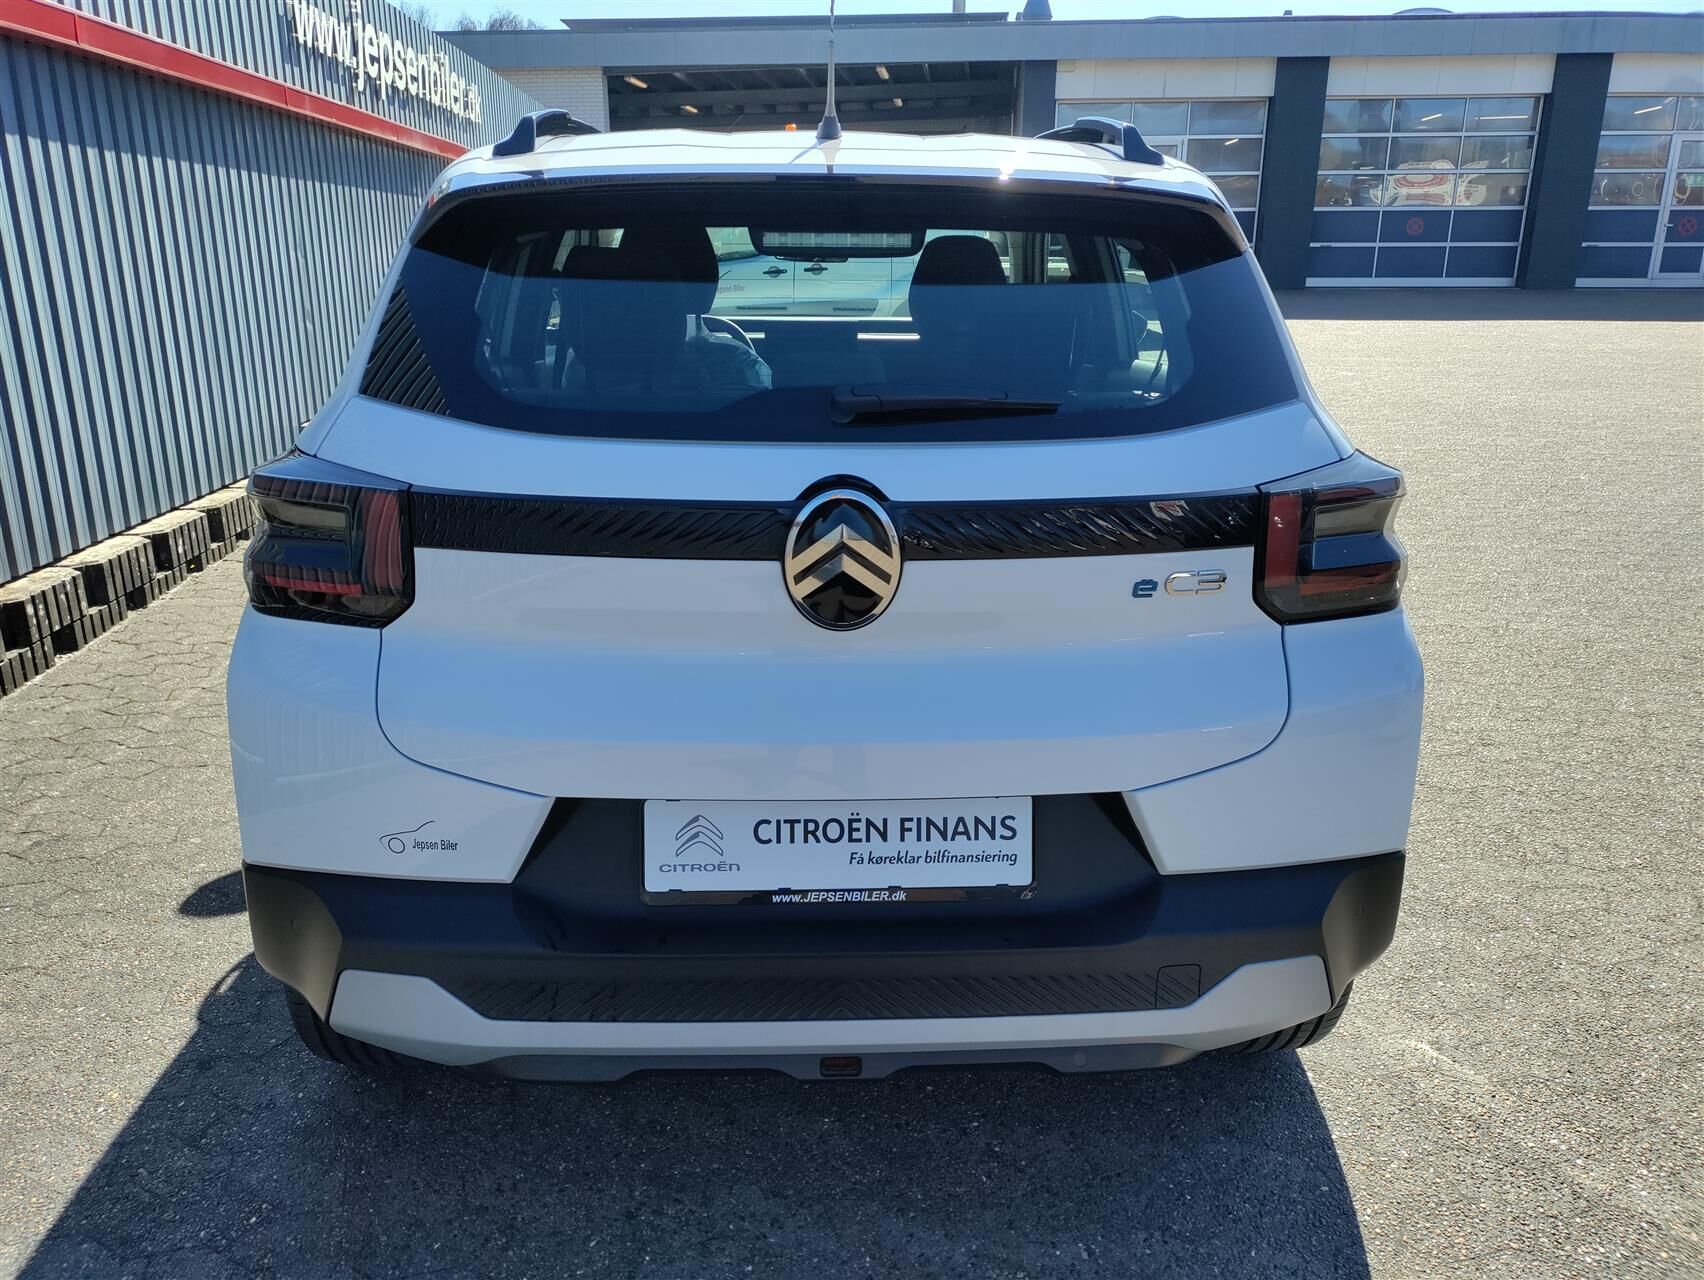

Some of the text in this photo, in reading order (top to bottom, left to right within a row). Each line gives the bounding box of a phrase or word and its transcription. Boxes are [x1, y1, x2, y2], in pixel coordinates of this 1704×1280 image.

[292, 0, 482, 124] www.jepsenbiler.dk
[754, 812, 1018, 845] CITROËN FINANS
[412, 839, 458, 851] Jepsen Biler
[849, 849, 1018, 866] Få køreklar bilfinansiering
[772, 891, 907, 903] www.JEPSENBILER.dk
